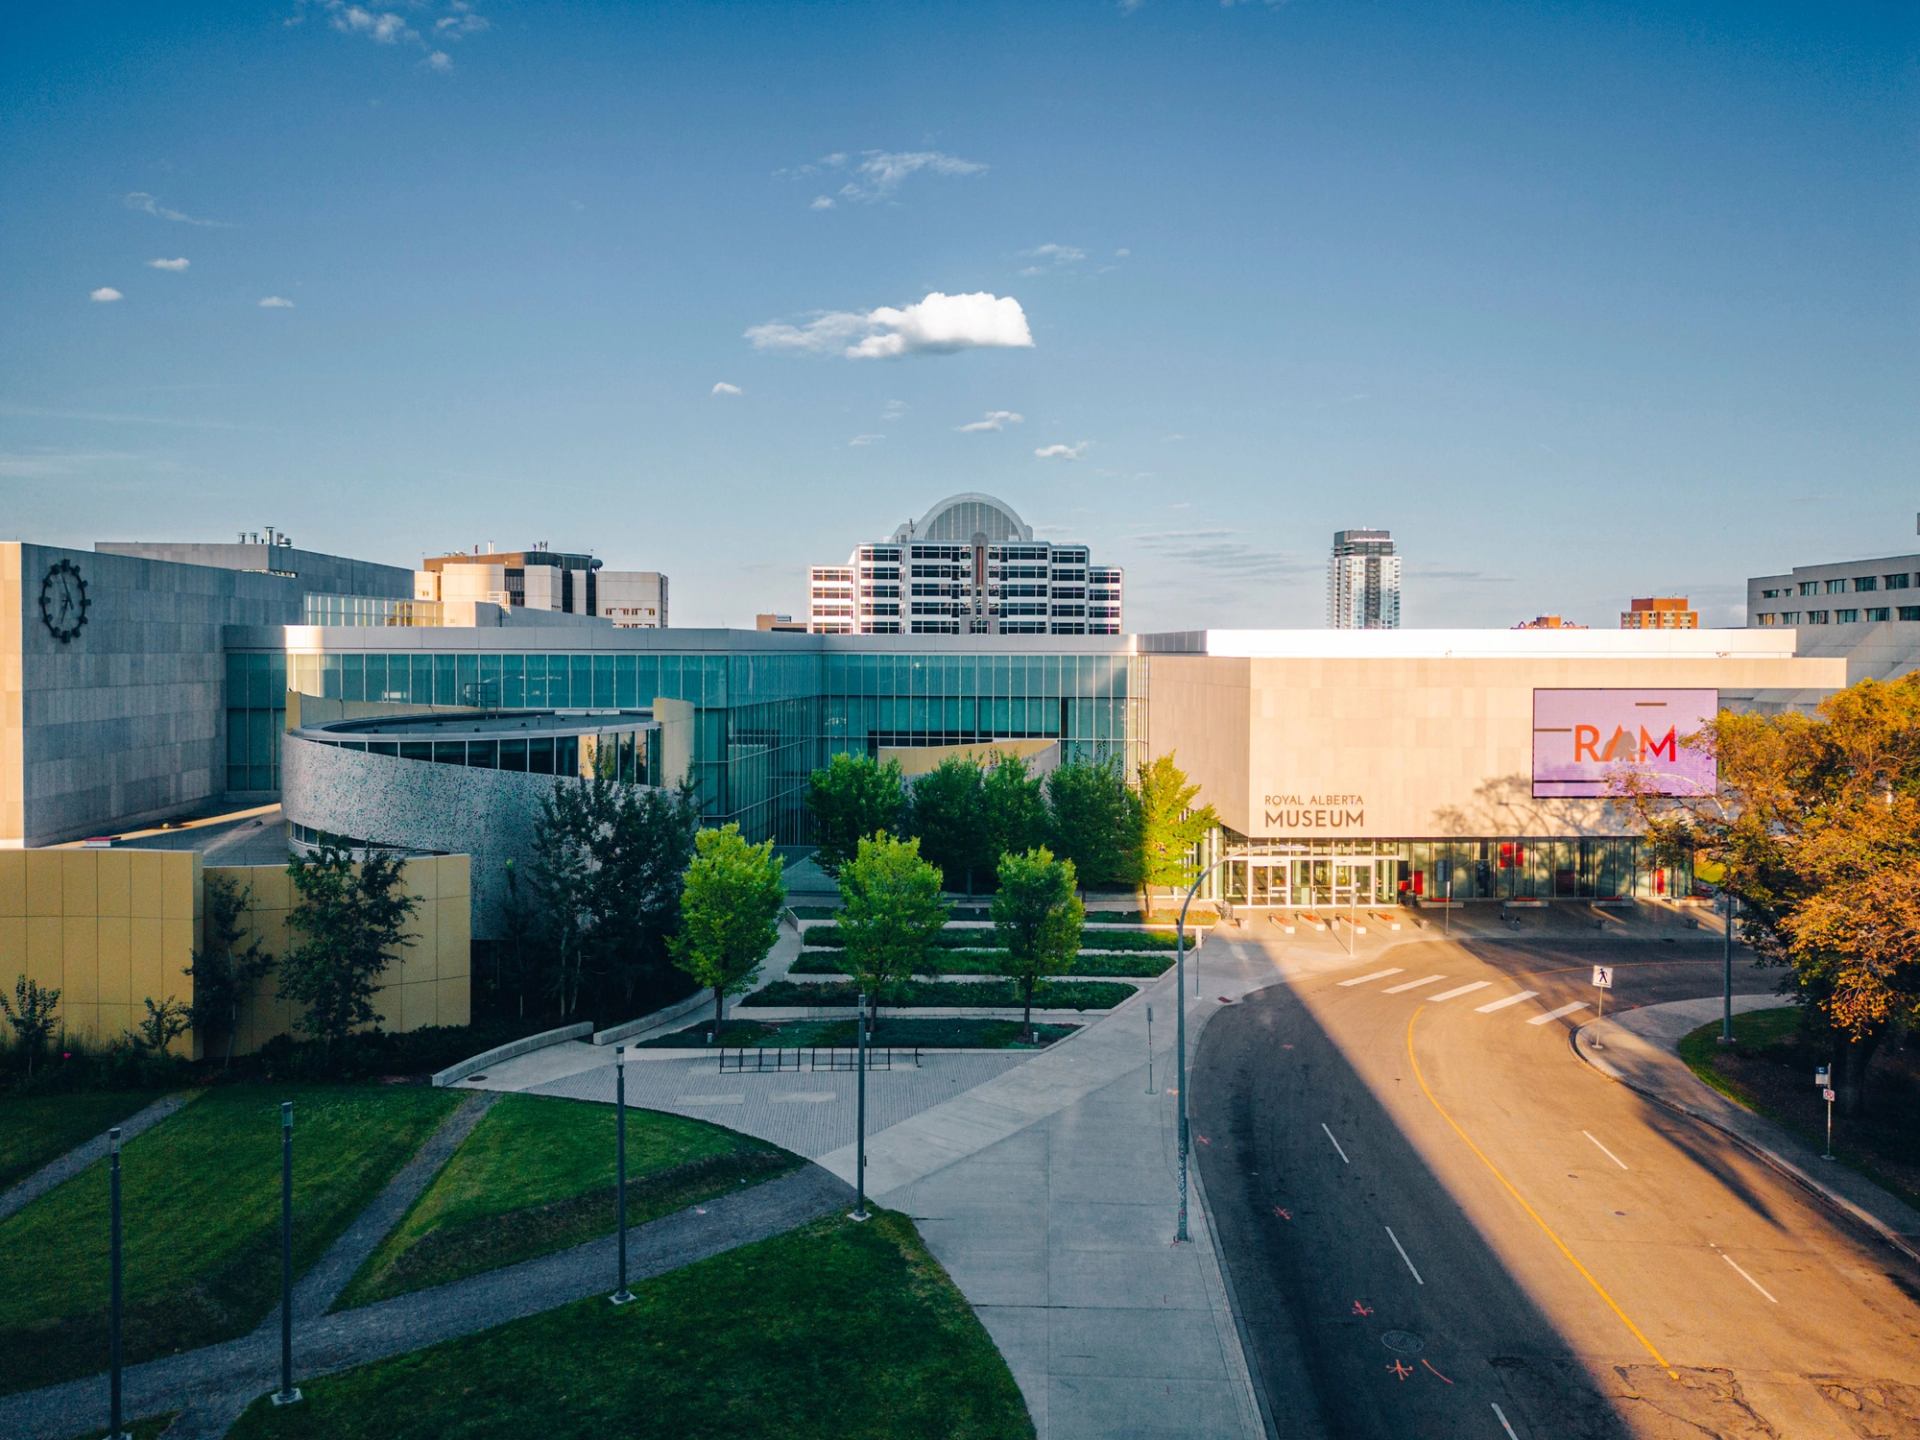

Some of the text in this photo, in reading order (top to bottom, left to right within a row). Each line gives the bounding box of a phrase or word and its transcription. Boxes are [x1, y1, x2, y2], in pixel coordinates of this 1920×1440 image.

[1574, 724, 1676, 762] RAM
[1265, 795, 1364, 806] ROYAL ALBERTA
[1265, 809, 1364, 828] MUSEUM
